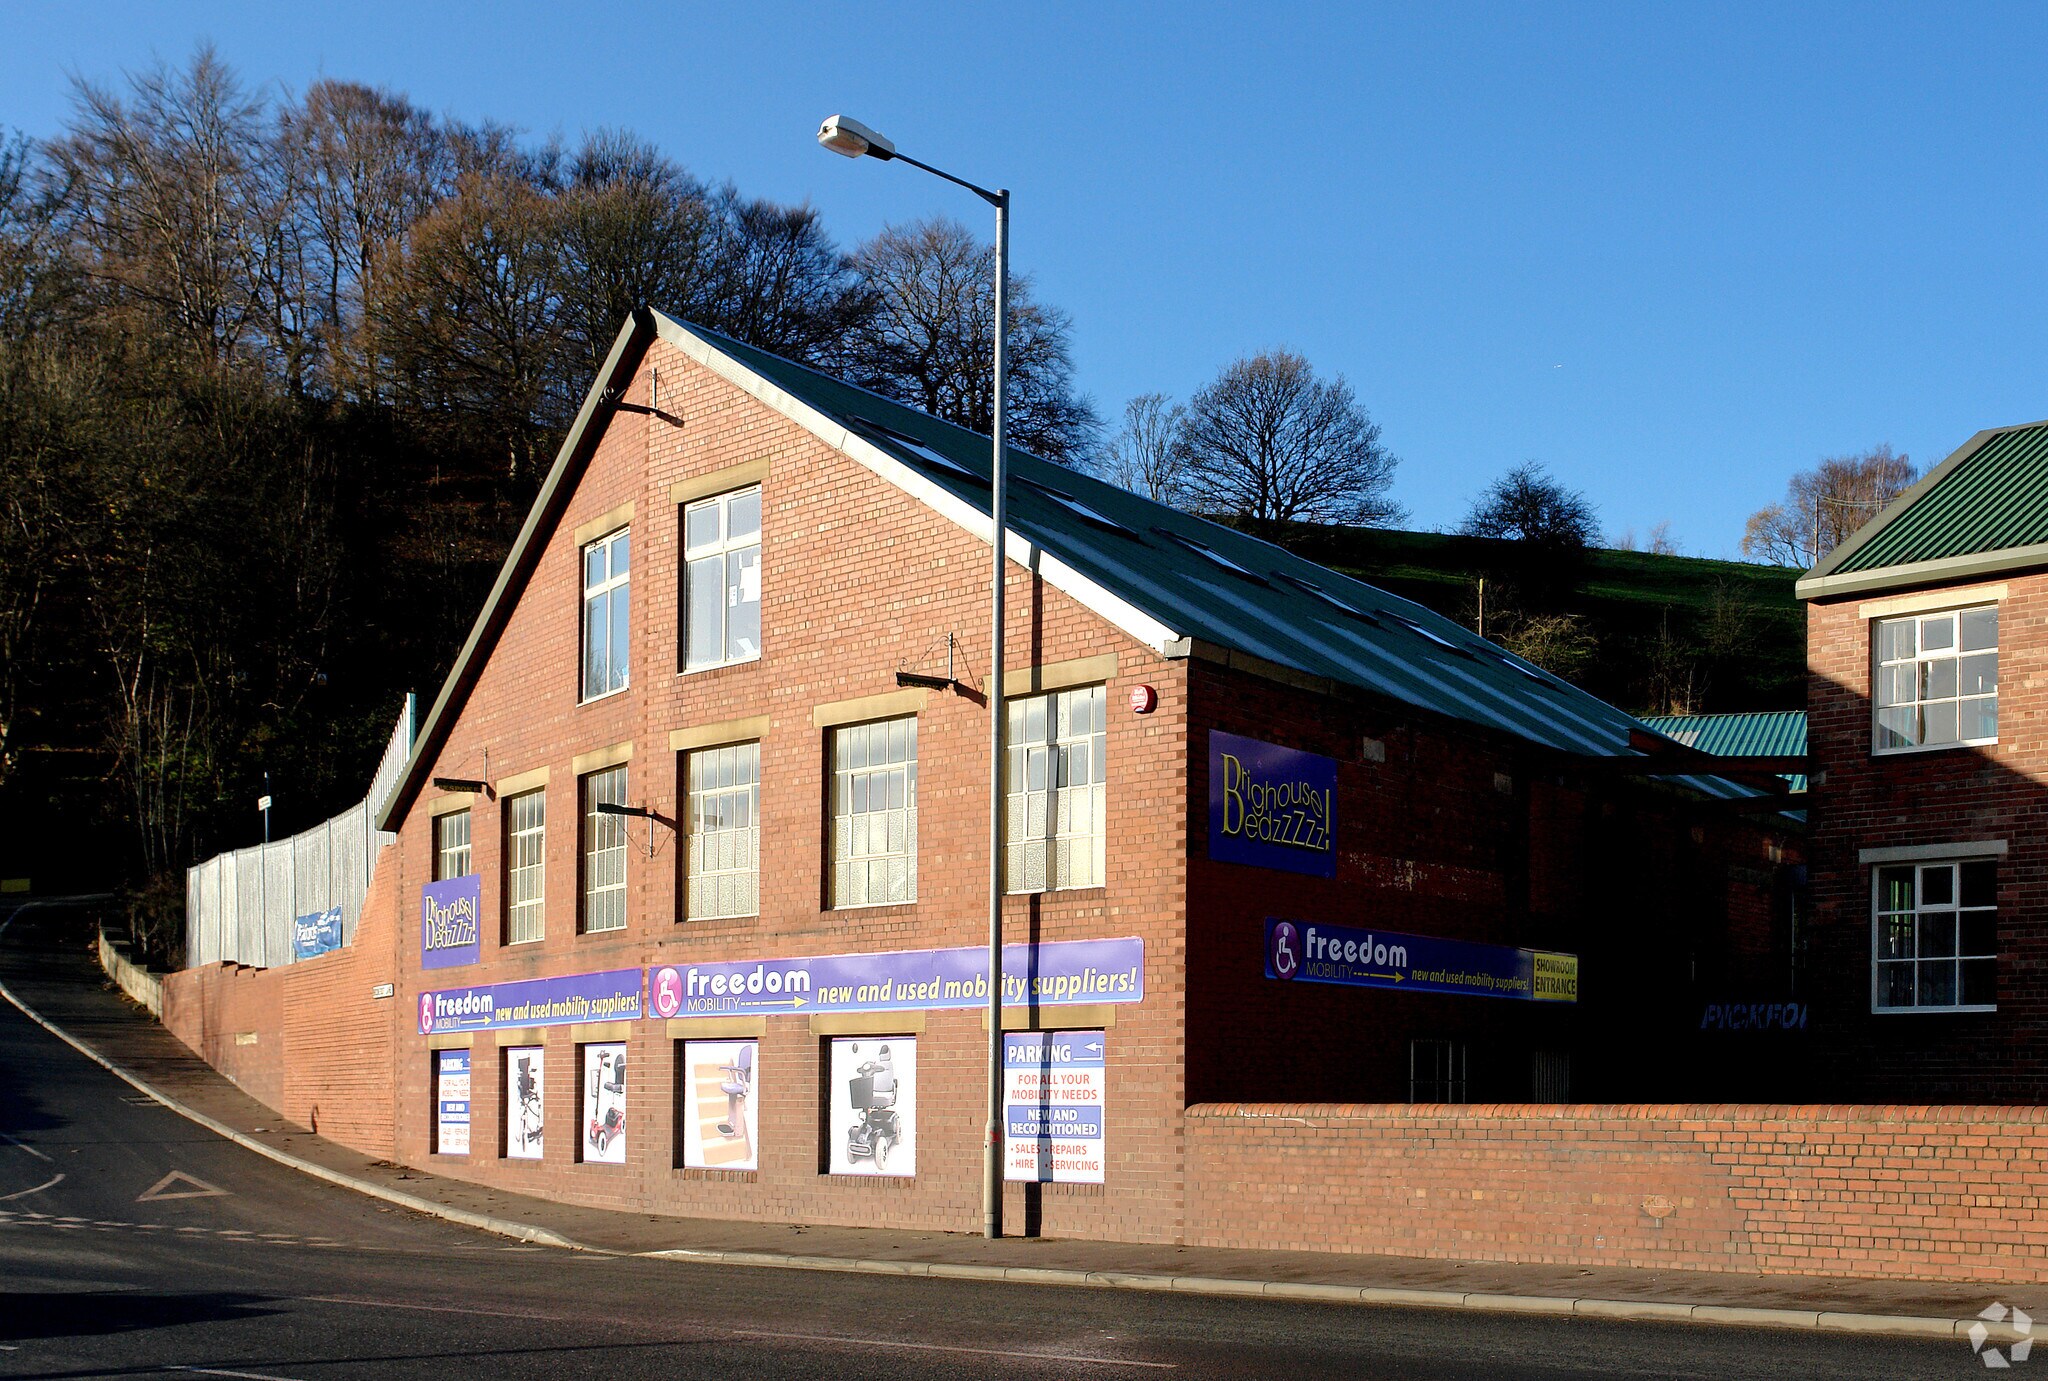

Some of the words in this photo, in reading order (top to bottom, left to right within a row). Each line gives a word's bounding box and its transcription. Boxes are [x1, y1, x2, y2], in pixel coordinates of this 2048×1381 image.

[1220, 752, 1323, 820] Brighouse
[425, 896, 472, 936] Brighouse
[1306, 927, 1408, 968] freedom
[1306, 962, 1353, 979] MOBILITY
[1536, 958, 1575, 975] SHOWROOM
[686, 964, 811, 997] freedom
[817, 986, 853, 1004] new
[856, 978, 893, 1003] and
[896, 975, 941, 1001] used
[944, 973, 1028, 1002] mobity
[1032, 967, 1137, 1001] suppliers!
[1412, 969, 1428, 980] new
[1430, 969, 1445, 983] and
[1446, 971, 1464, 984] used
[1465, 973, 1495, 990] mobility
[1495, 976, 1529, 991] suppliers!
[1536, 977, 1576, 995] ENTRANCE
[435, 990, 493, 1017] freedom
[495, 1007, 512, 1021] new
[513, 1000, 530, 1020] and
[530, 998, 551, 1019] used
[552, 995, 590, 1020] mobility
[591, 991, 640, 1018] suppliers!
[687, 997, 741, 1012] MOBILITY
[436, 1016, 461, 1029] MOBILITY
[1008, 1044, 1071, 1063] PARKING
[1018, 1074, 1037, 1085] FOR
[1040, 1074, 1058, 1085] ALL
[1061, 1074, 1090, 1085] YOUR
[1012, 1090, 1059, 1100] MOBILITY
[1062, 1090, 1098, 1100] NEEDS
[1027, 1109, 1051, 1121] NEW
[1053, 1109, 1078, 1121] AND
[1010, 1122, 1098, 1136] RECONDITIONED
[1015, 1144, 1040, 1154] SALES
[1050, 1145, 1087, 1155] REPAIRS
[1015, 1159, 1035, 1169] HIRE
[1050, 1160, 1099, 1171] SERVICING
